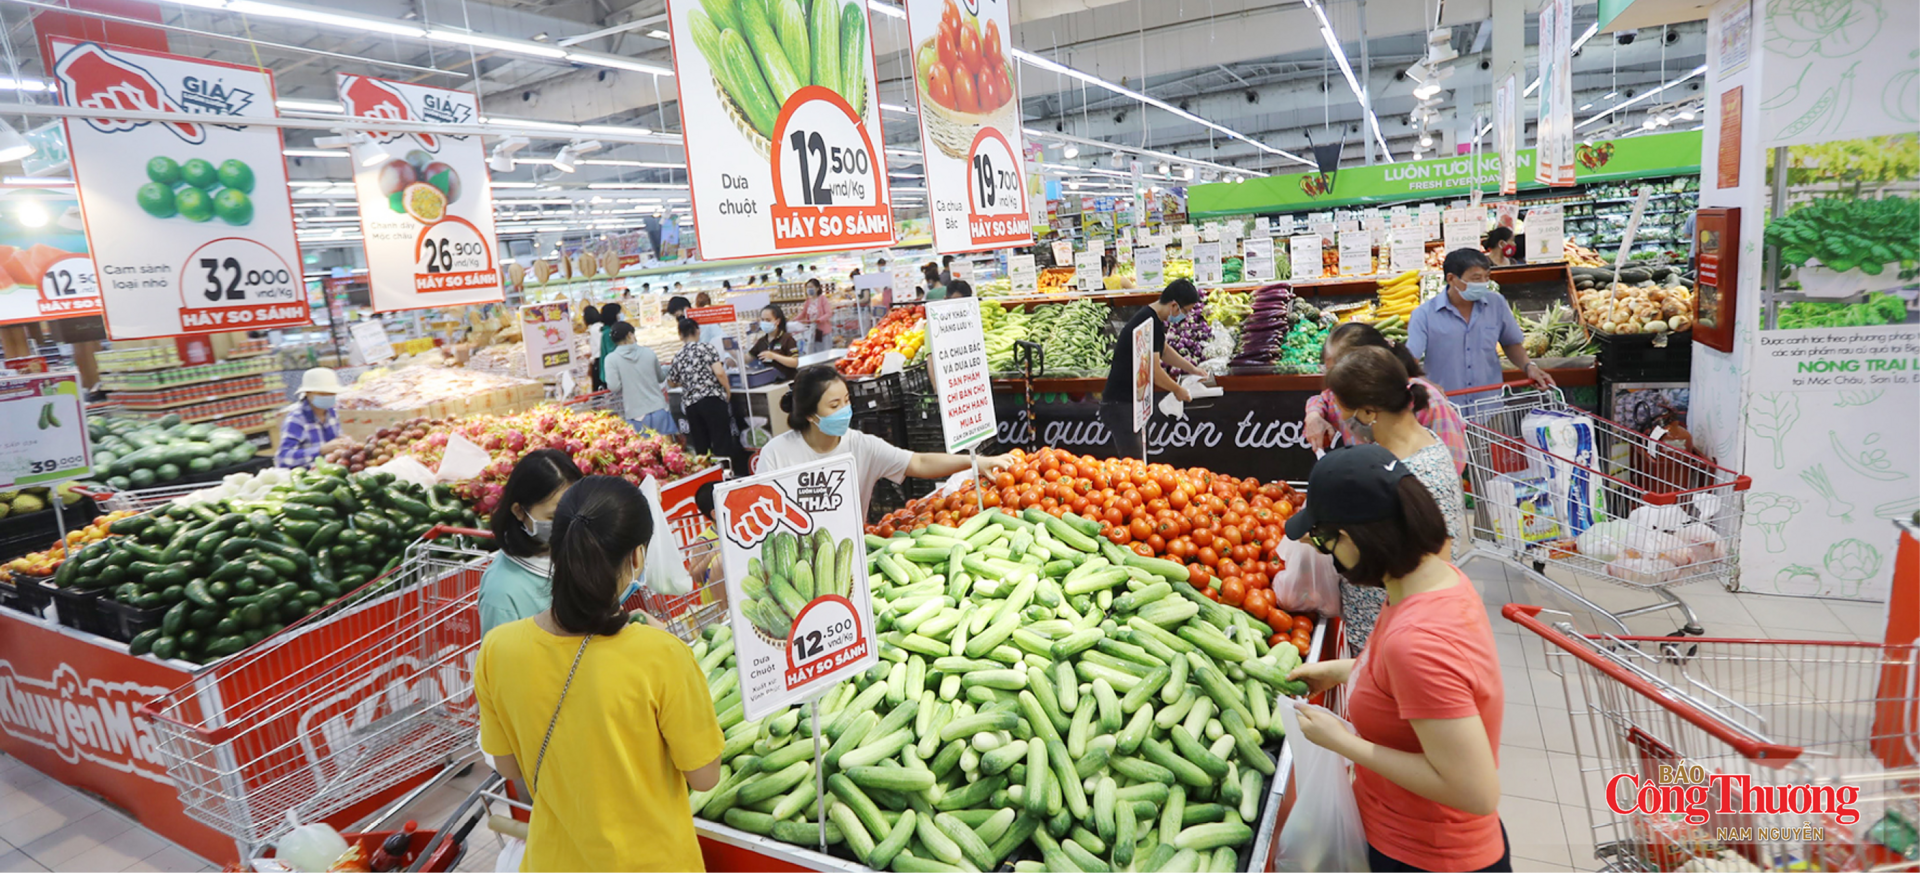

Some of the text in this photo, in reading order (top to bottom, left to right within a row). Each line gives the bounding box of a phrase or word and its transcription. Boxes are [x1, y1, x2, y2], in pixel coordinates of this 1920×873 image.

[182, 75, 227, 101] GIÁ
[424, 93, 454, 113] GIÁ
[721, 173, 749, 189] Dưa
[973, 153, 1018, 208] 19.700
[1384, 164, 1430, 182] LUÔN
[1409, 174, 1501, 190] FRESH EVERYDAY
[719, 198, 758, 218] chuột
[775, 210, 889, 239] HÃY SO SÁNH
[970, 218, 992, 238] HÃY
[993, 221, 1006, 237] SO
[1006, 217, 1030, 236] SÁNH
[424, 238, 482, 273] 26.900
[103, 264, 137, 275] Cam
[113, 279, 138, 290] loại
[200, 257, 290, 302] 32.000
[417, 273, 496, 289] HÃY SO SÁNH
[255, 287, 293, 299] vnd/Kg
[182, 306, 304, 327] HÃY SO SÁNH
[1786, 335, 1809, 344] canh
[1827, 333, 1847, 342] theo
[949, 345, 968, 358] CHUA
[1838, 347, 1854, 355] rau
[1797, 357, 1861, 373] NÔNG
[1865, 358, 1907, 375] TRẠI
[973, 383, 986, 395] CHO
[960, 416, 974, 429] MUA
[30, 455, 83, 473] 39.000
[797, 467, 827, 487] GIÁ
[798, 493, 842, 512] THẤP
[793, 618, 852, 661] 12.500
[827, 631, 854, 648] vnd/Kg
[753, 655, 770, 667] Dưa
[787, 643, 866, 686] HÃY SO SÁNH
[750, 663, 776, 679] Chuột
